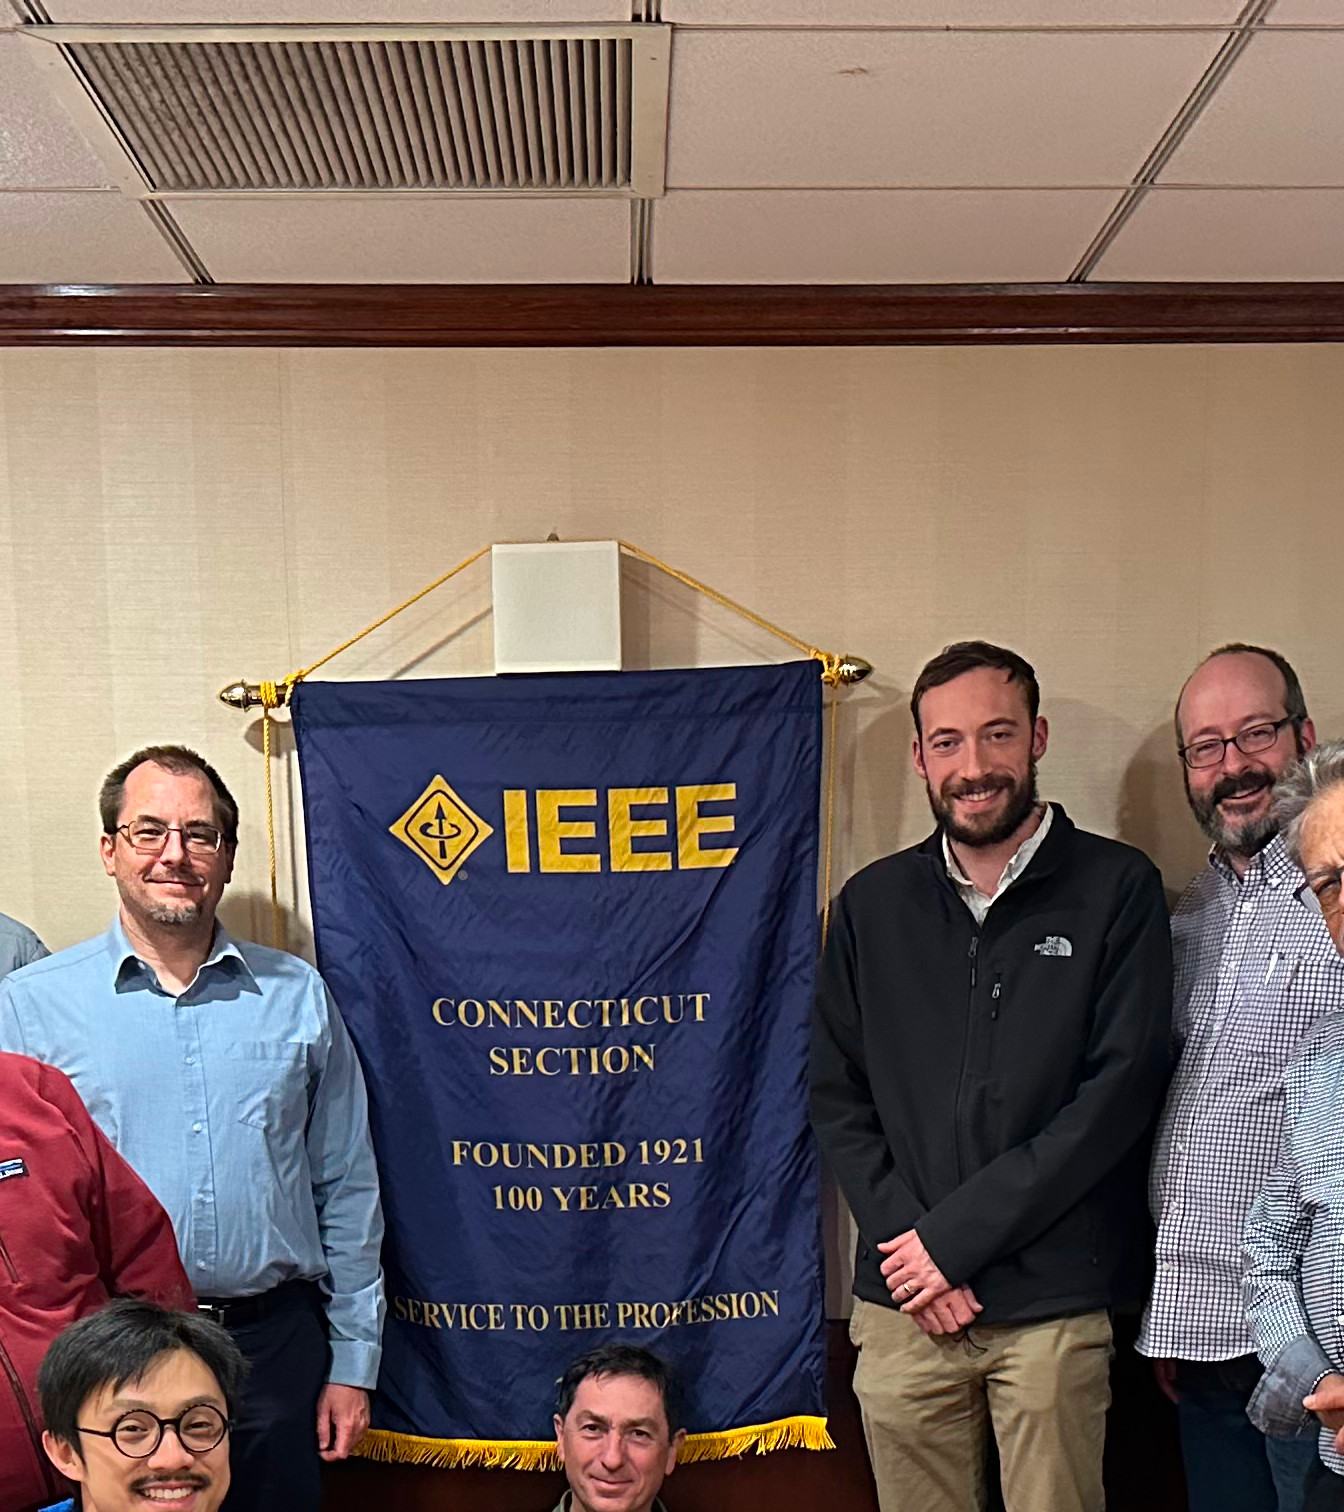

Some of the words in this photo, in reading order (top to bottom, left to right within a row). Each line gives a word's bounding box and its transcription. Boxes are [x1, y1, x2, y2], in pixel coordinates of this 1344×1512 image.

[503, 783, 739, 873] IEEE
[432, 993, 710, 1028] CONNECTICUT
[489, 1044, 656, 1076] SECTION
[451, 1140, 626, 1169] FOUNDED
[638, 1138, 704, 1165] 1921
[492, 1185, 543, 1212] 100
[552, 1182, 671, 1212] YEARS
[394, 1295, 505, 1330] SERVICE
[510, 1304, 549, 1331] TO
[554, 1303, 611, 1330] THE
[616, 1290, 779, 1329] PROFESSION
